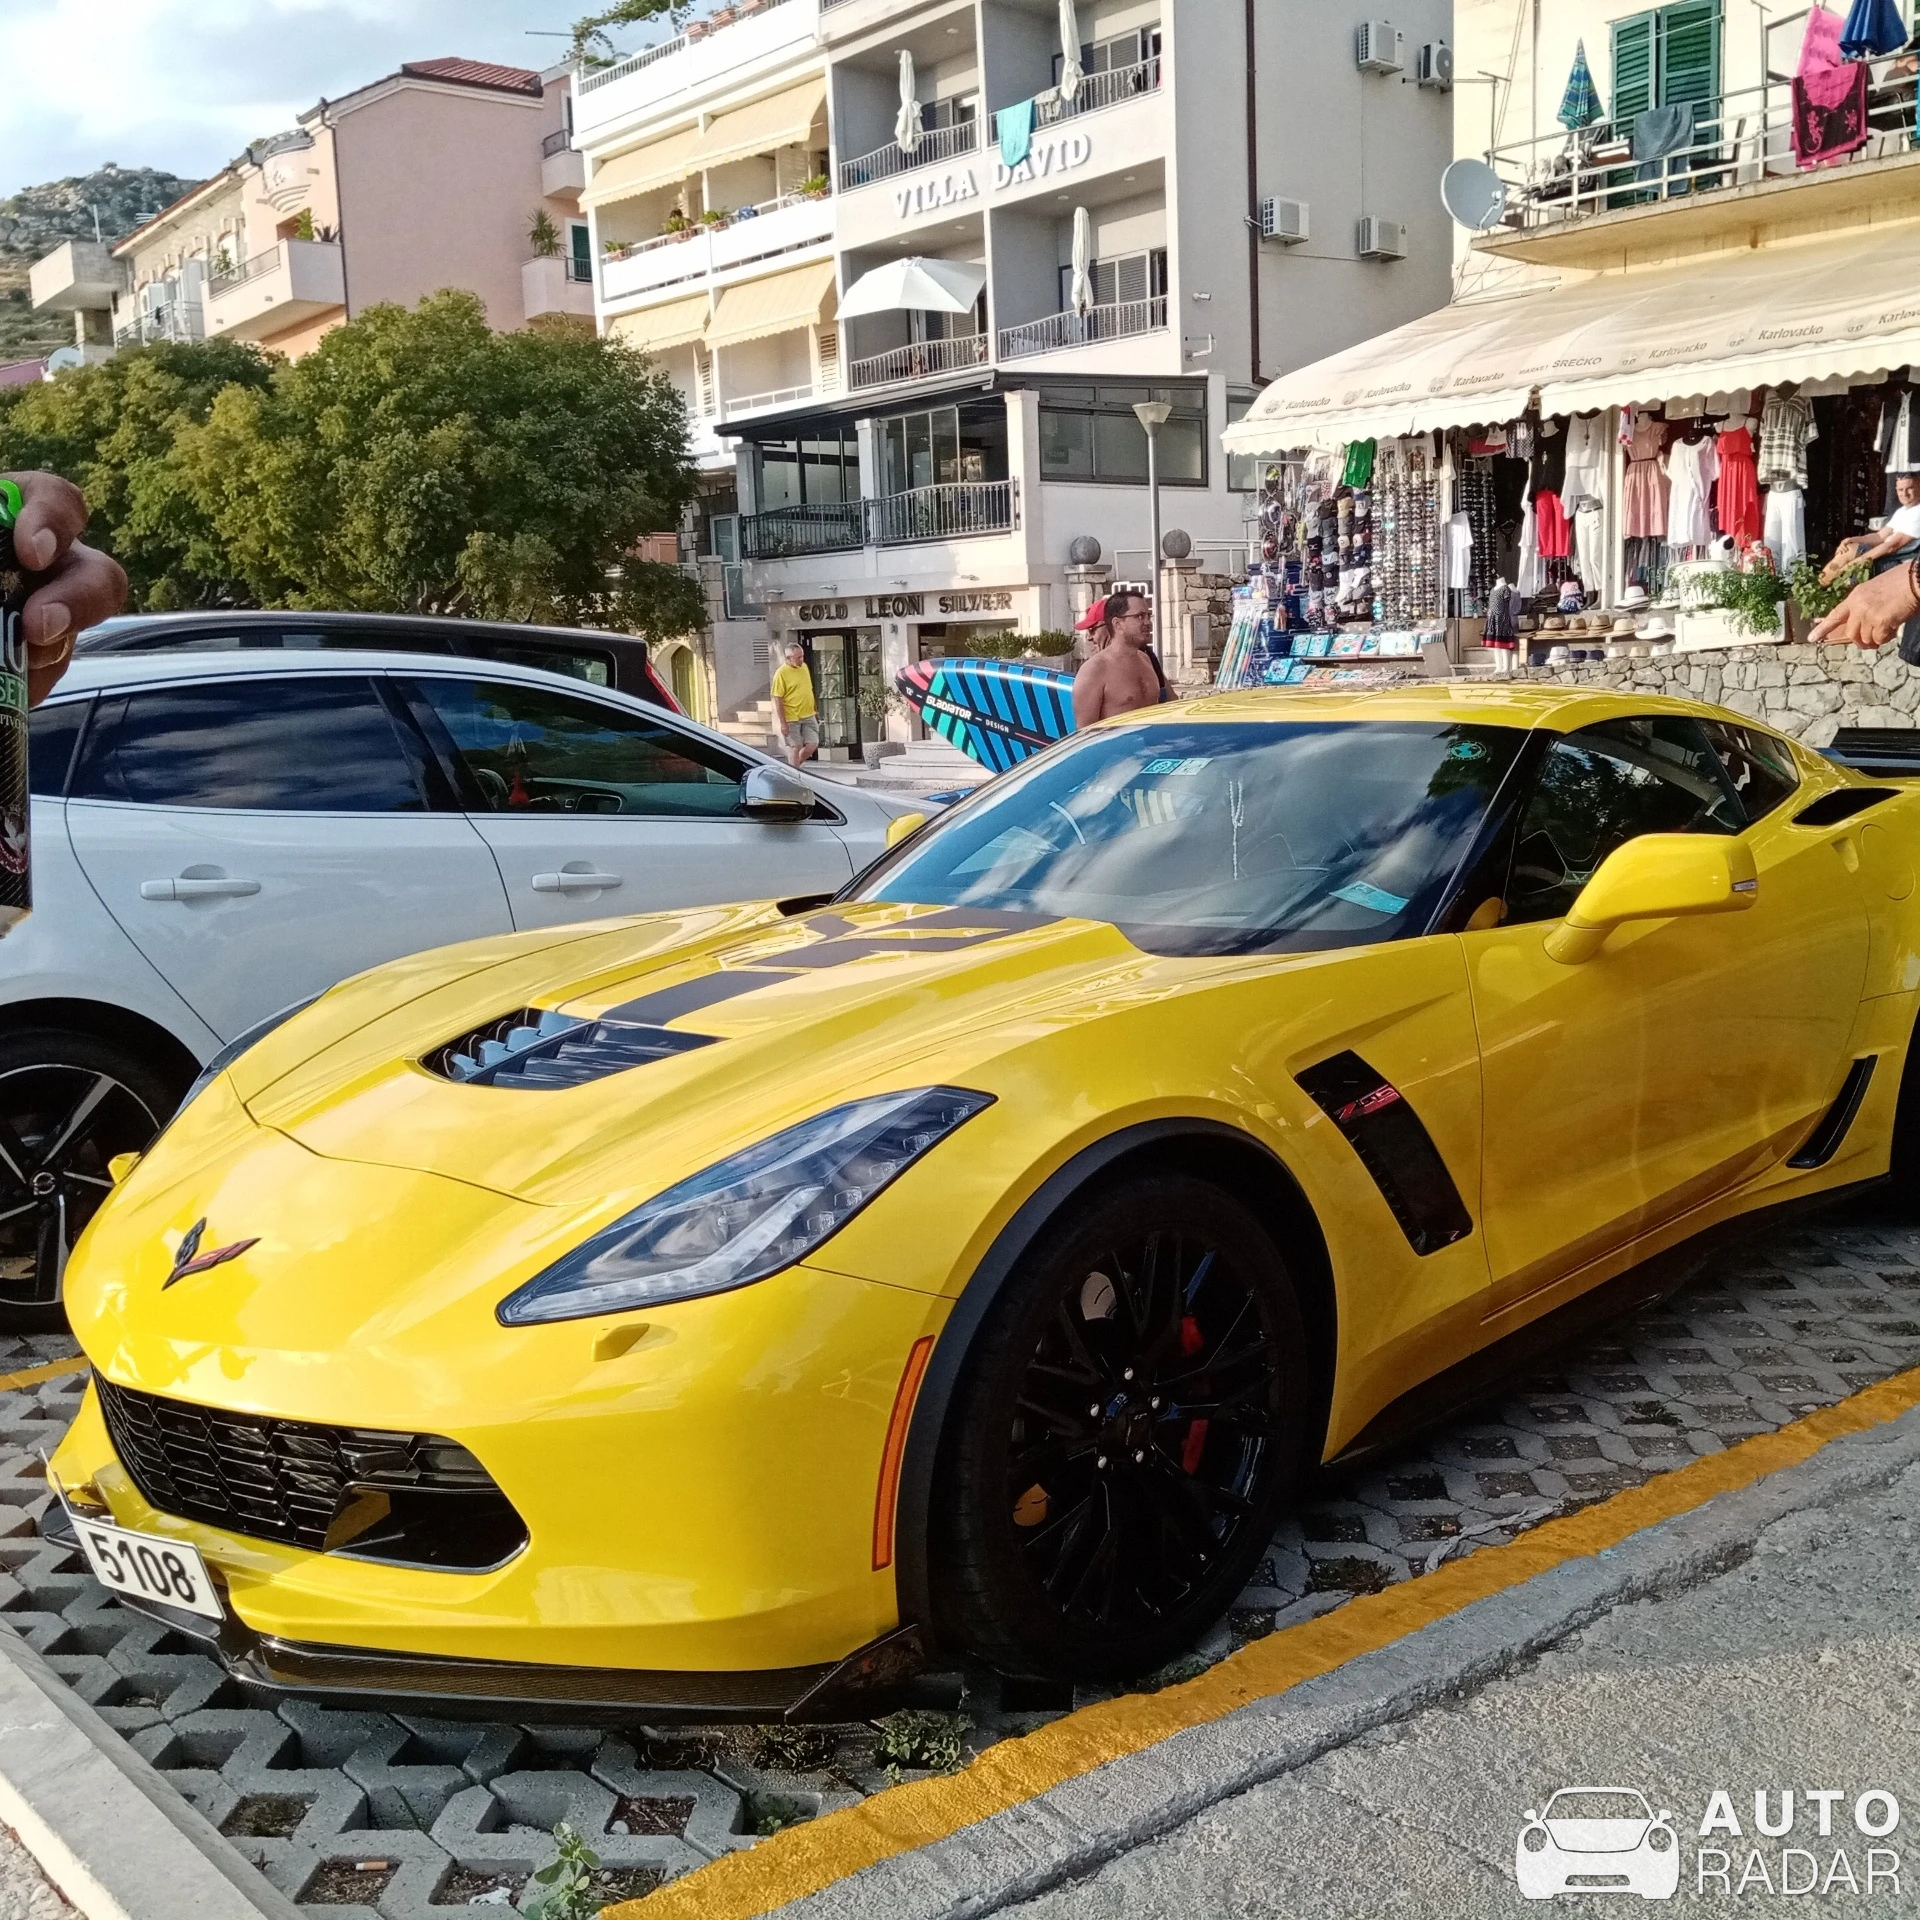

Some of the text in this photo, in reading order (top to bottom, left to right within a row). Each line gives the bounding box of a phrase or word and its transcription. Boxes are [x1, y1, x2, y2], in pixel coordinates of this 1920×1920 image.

[891, 134, 1091, 218] VILLA DAVID
[799, 592, 1013, 621] GOLD LEON SILVER
[925, 695, 972, 720] GLADIATOR
[985, 719, 1009, 733] DESIGN
[88, 1531, 196, 1604] 5108
